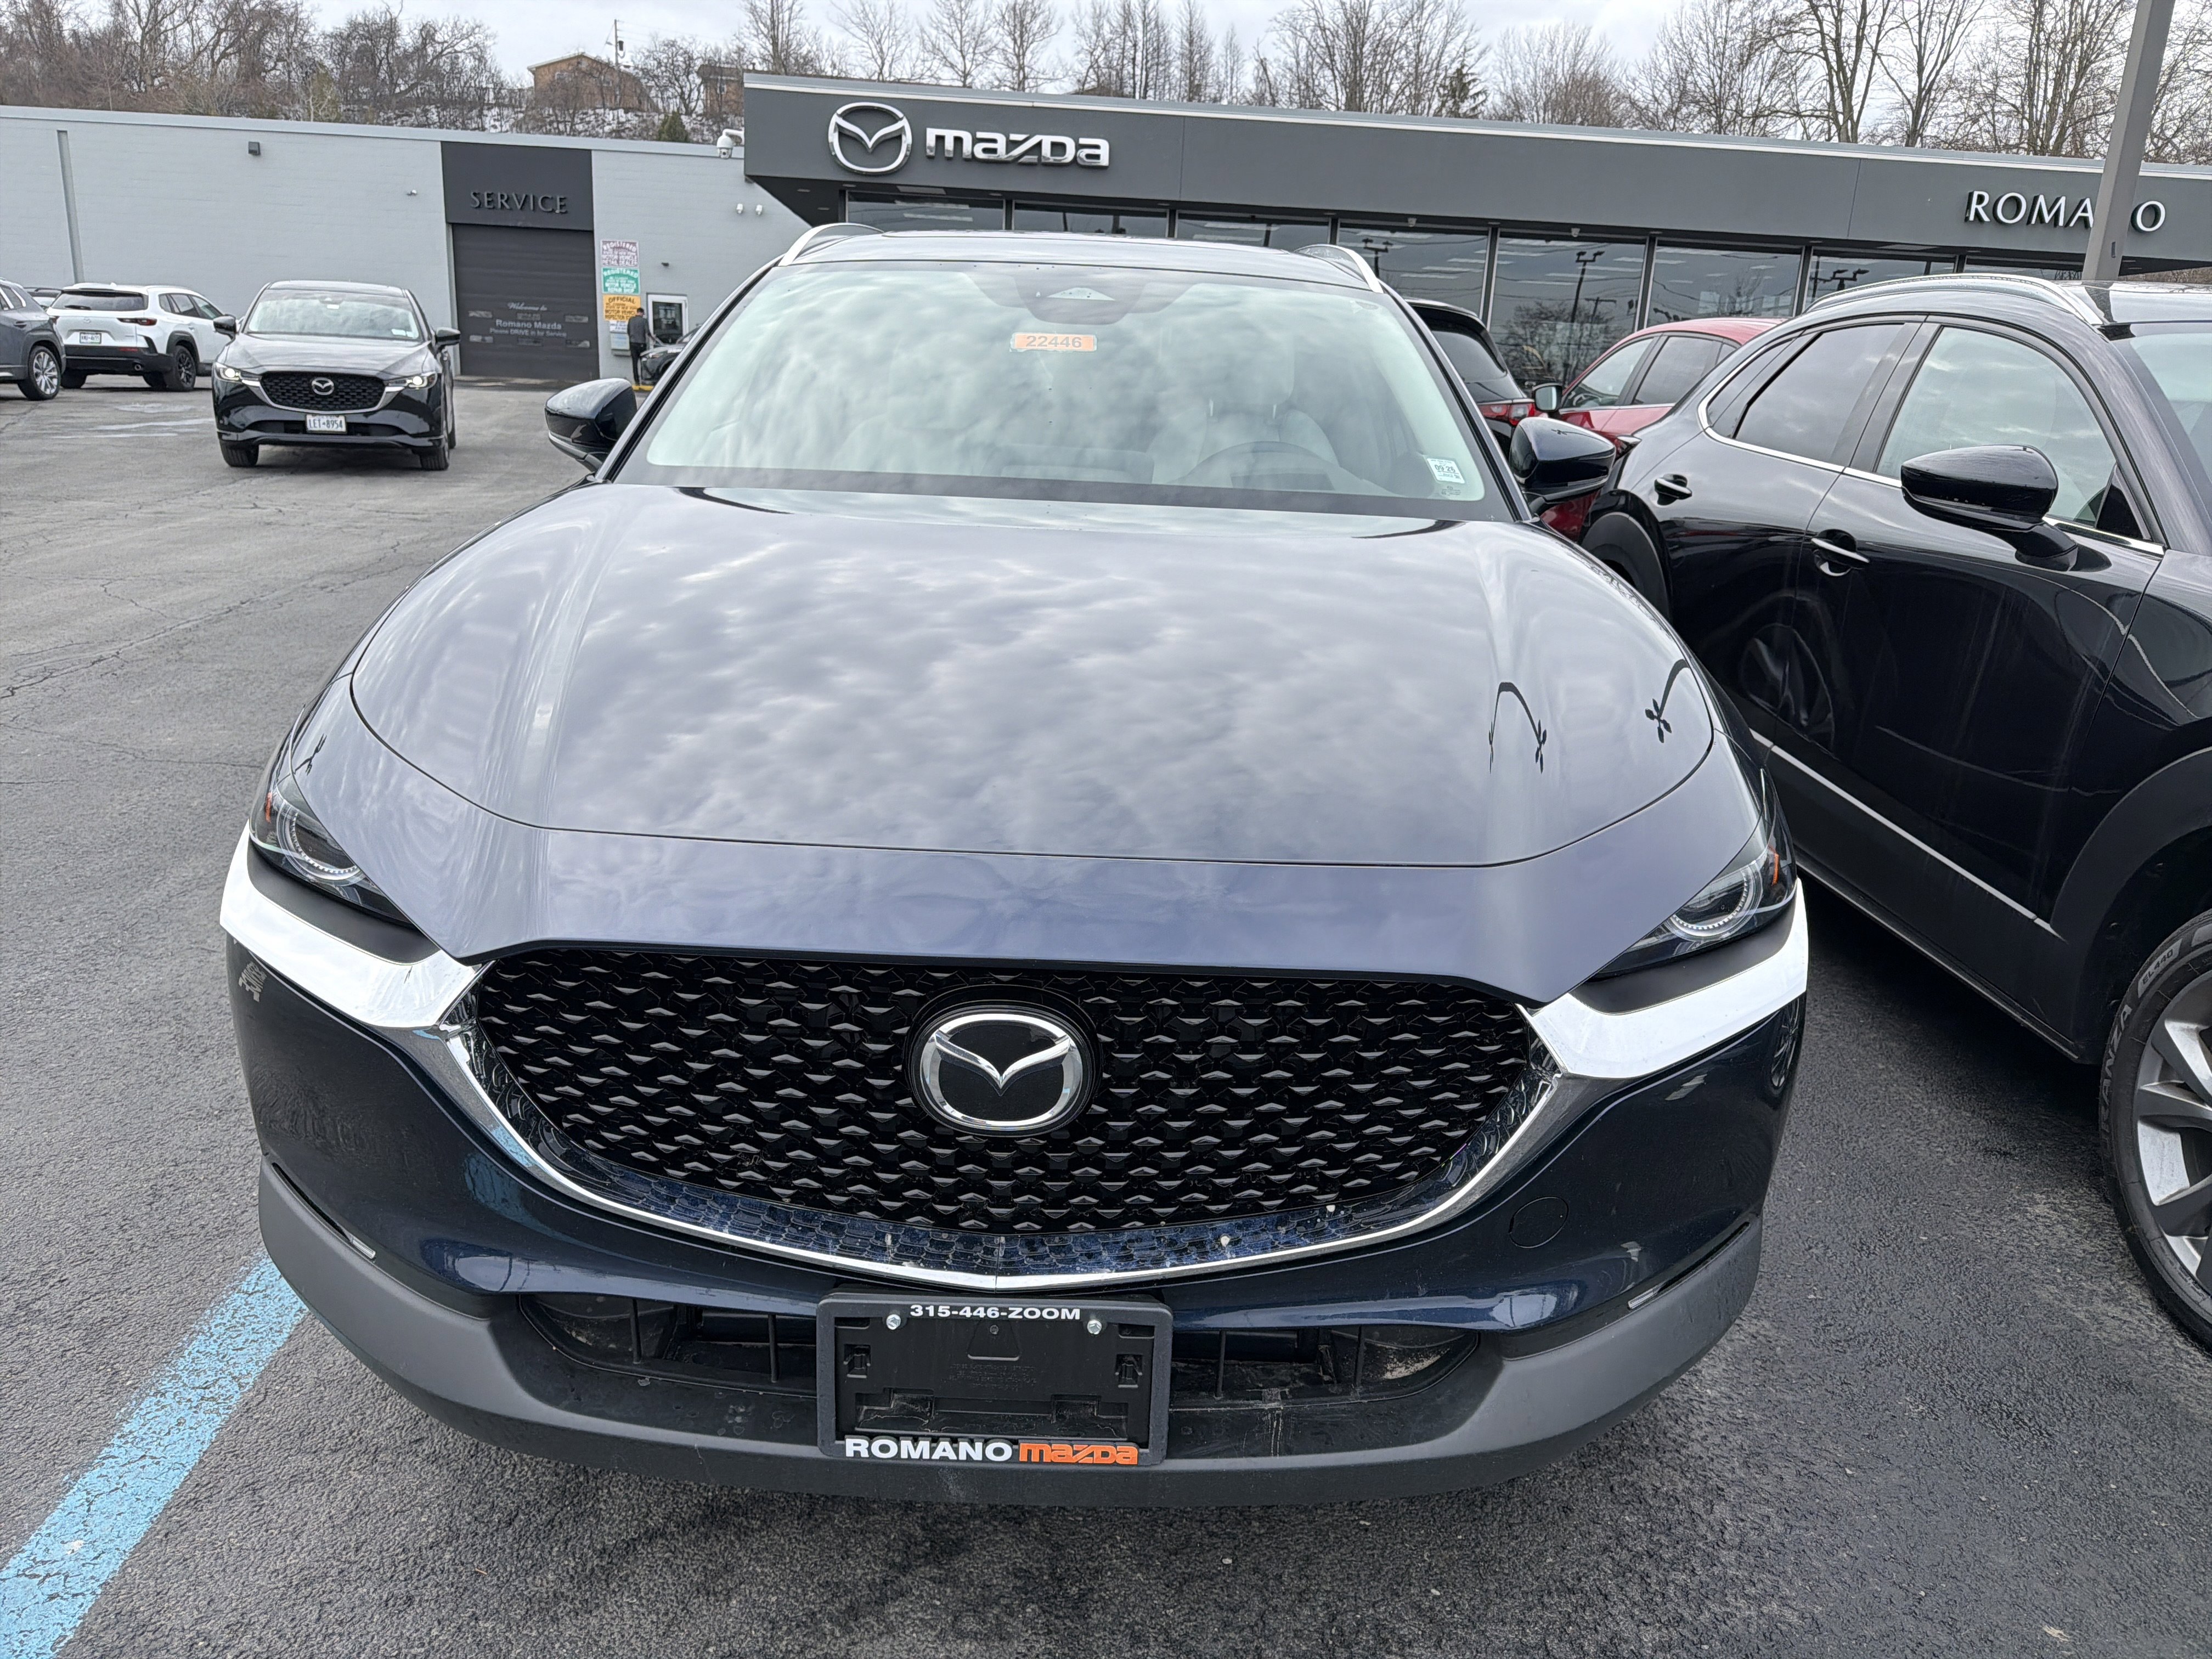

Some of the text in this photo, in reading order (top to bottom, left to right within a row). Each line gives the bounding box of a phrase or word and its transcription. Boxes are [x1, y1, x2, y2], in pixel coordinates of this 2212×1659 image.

[470, 191, 568, 213] SERVICE
[1965, 190, 2166, 232] ROMAO
[602, 241, 636, 252] REGISTERED
[507, 302, 539, 311] Welcome
[495, 319, 562, 330] Romano Mazda
[1025, 335, 1082, 348] 22446
[910, 1305, 1081, 1321] 315-446-ZOOM
[845, 1438, 1013, 1462] ROMANO
